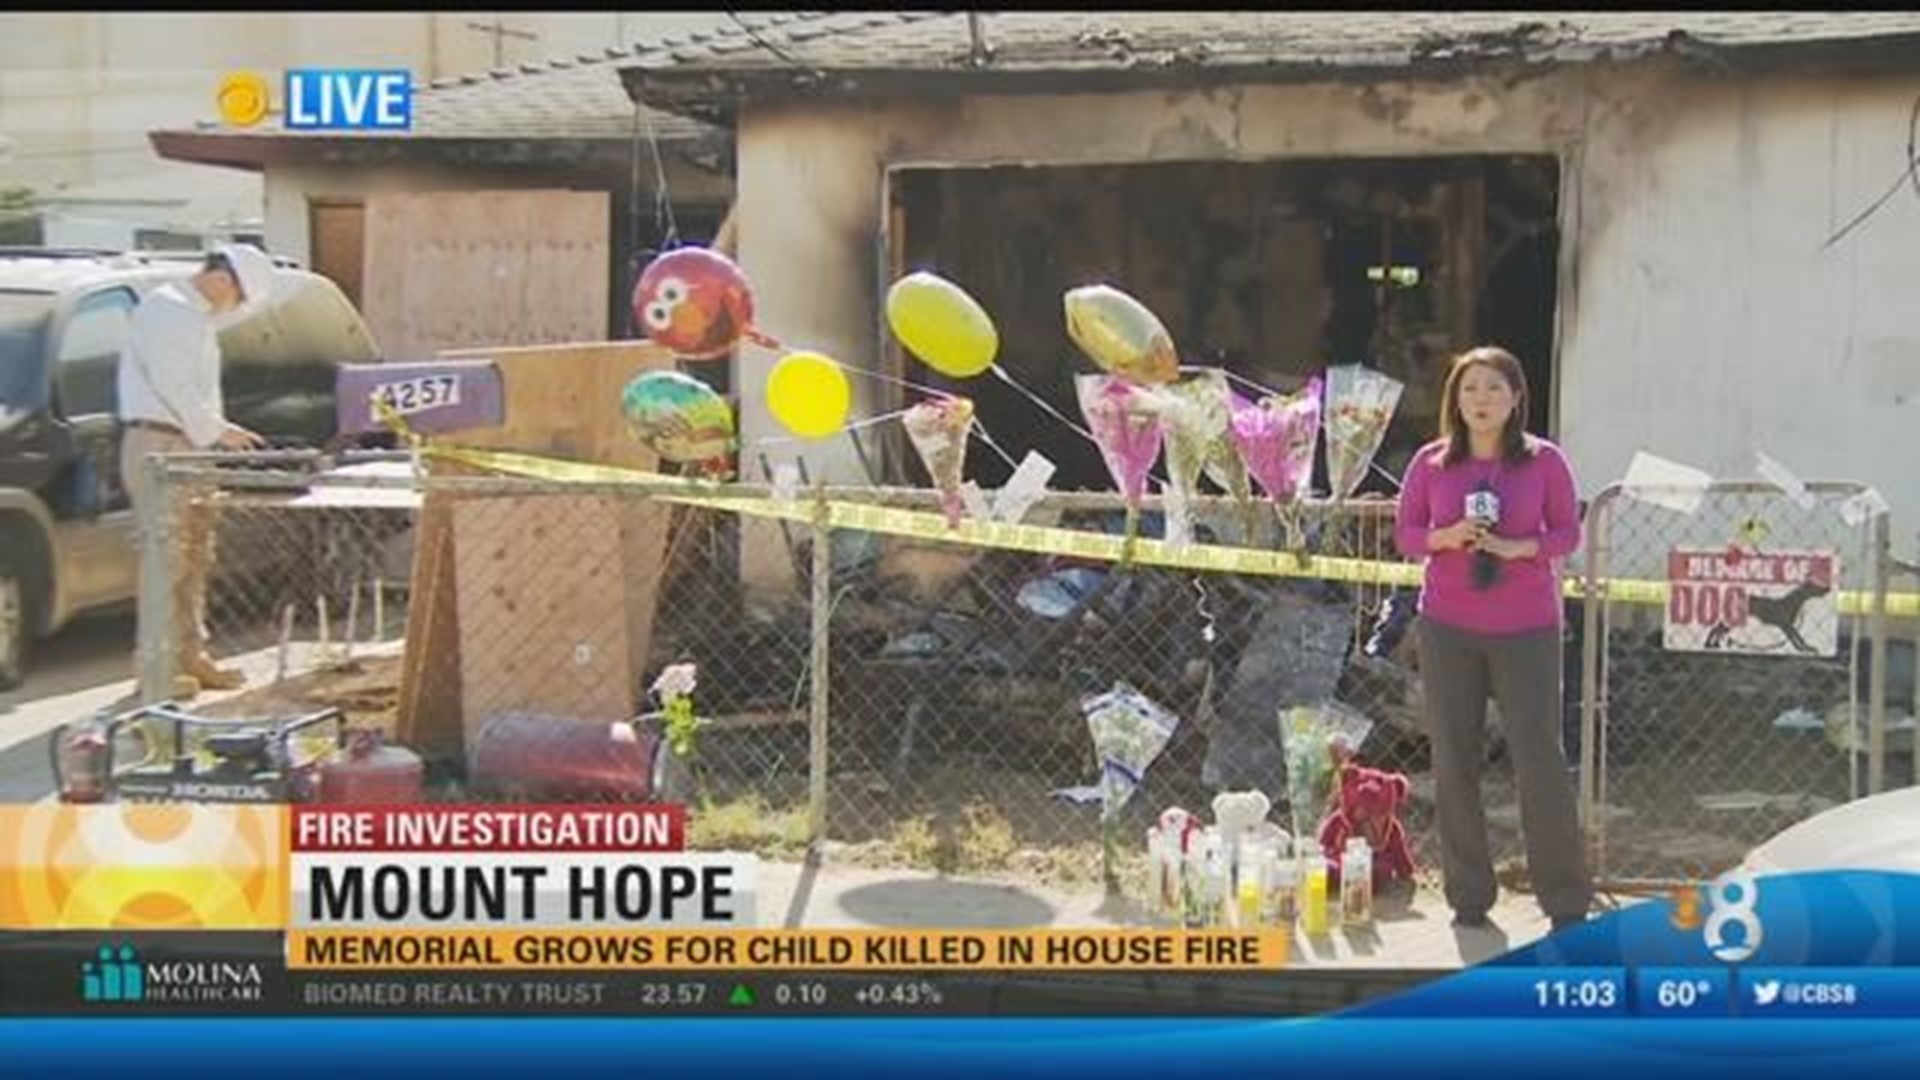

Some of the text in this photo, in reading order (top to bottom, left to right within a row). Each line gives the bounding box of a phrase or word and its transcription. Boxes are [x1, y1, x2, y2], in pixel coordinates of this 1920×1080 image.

[382, 377, 454, 408] 4257
[1782, 560, 1812, 581] OF
[1670, 584, 1748, 627] DOG
[171, 783, 270, 799] HONDA
